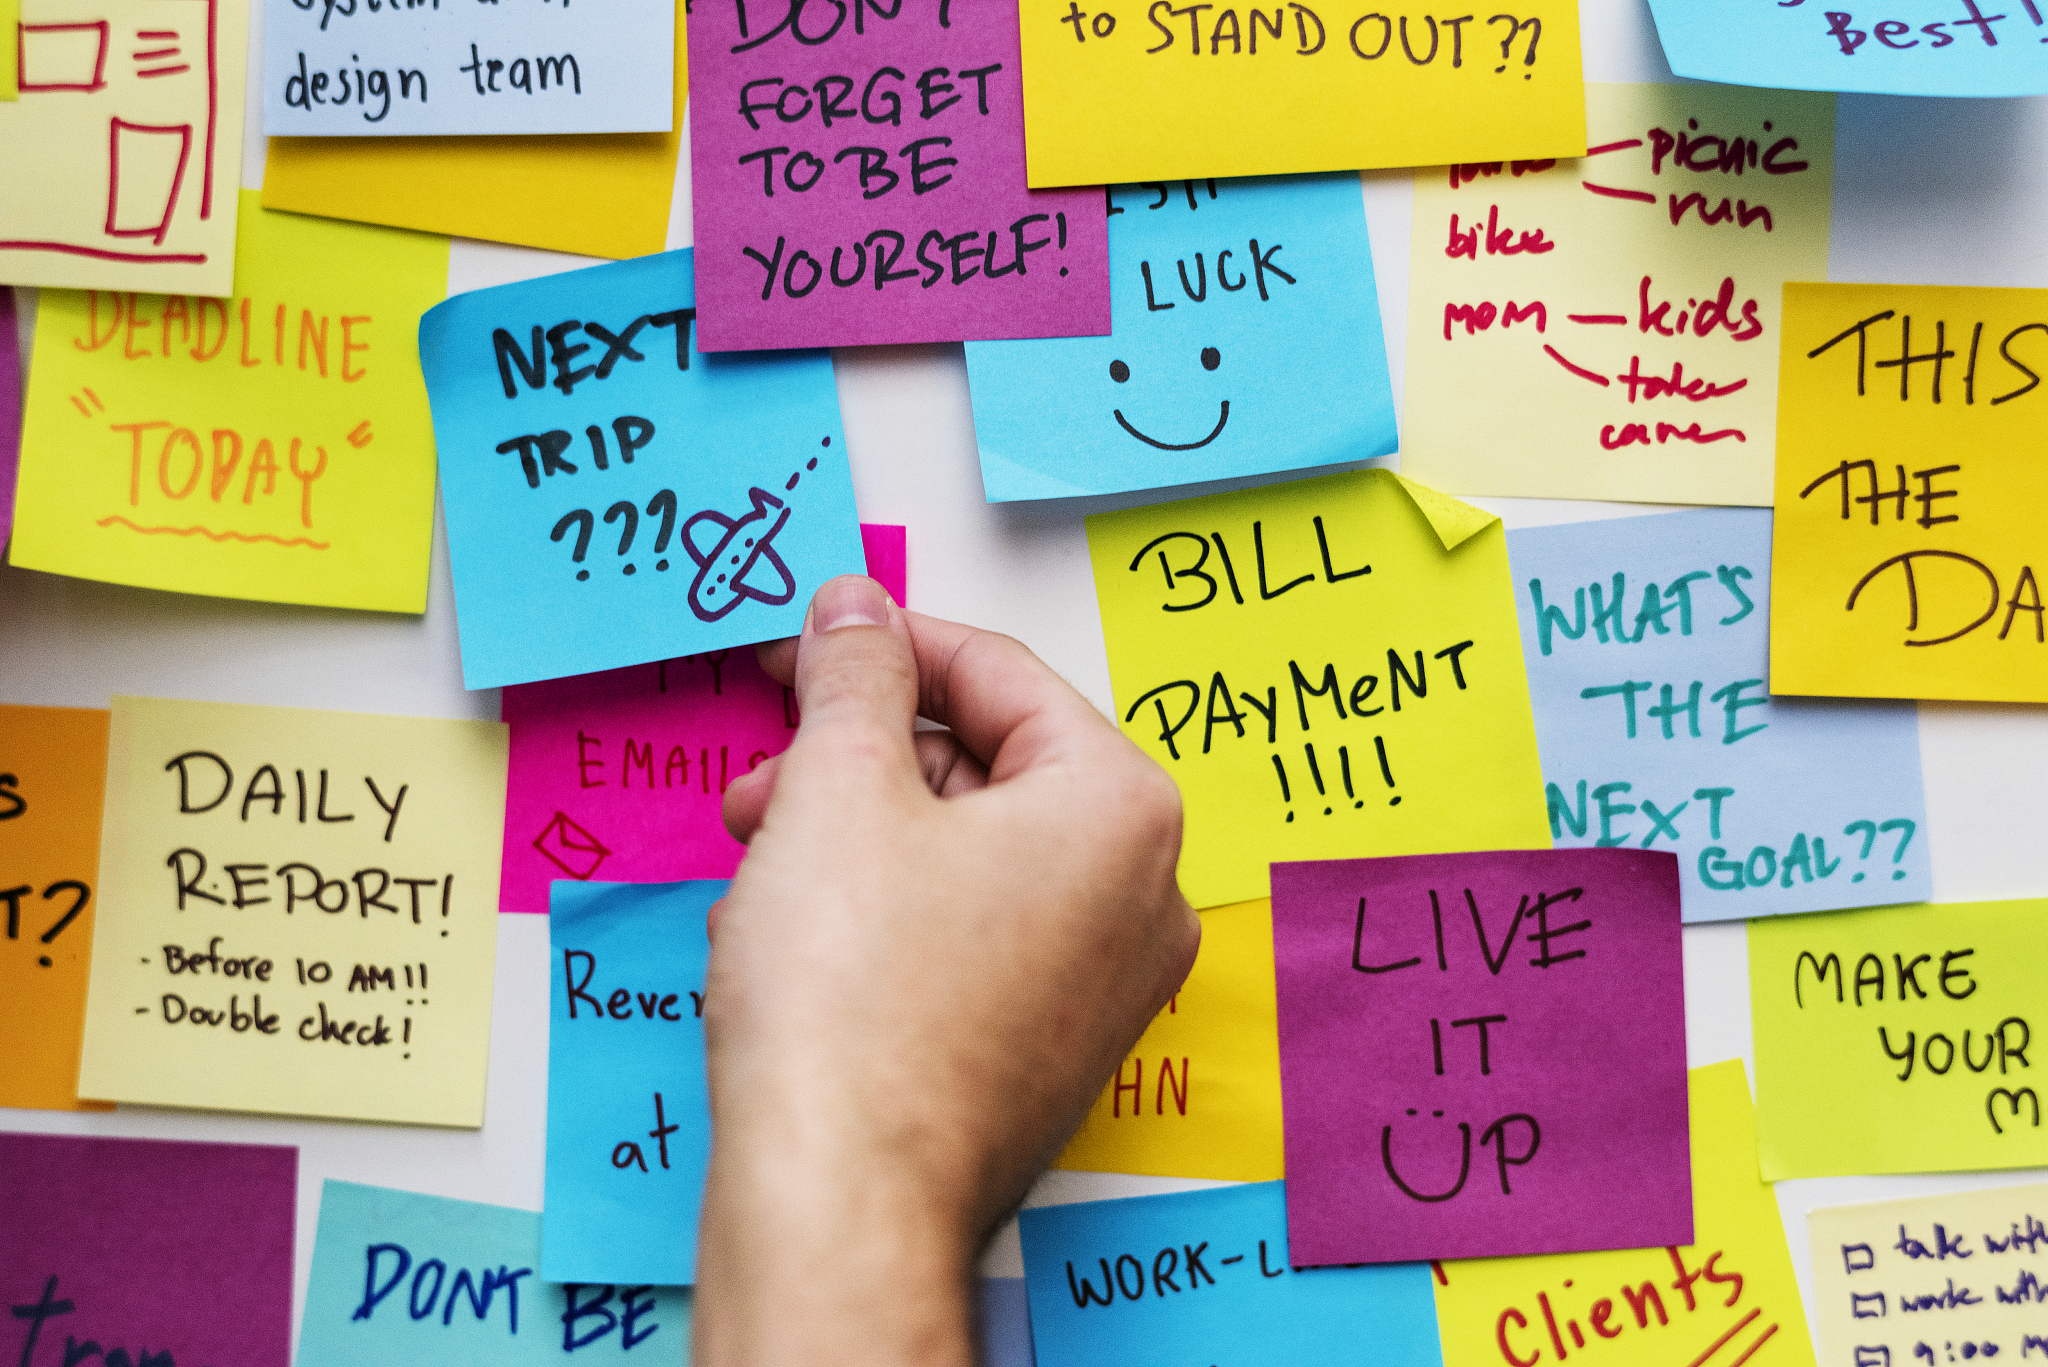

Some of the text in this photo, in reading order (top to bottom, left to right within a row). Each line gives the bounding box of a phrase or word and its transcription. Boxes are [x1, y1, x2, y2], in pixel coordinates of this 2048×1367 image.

[1146, 2, 1327, 57] STAND
[284, 43, 582, 122] design team
[738, 62, 1003, 130] FORGET
[738, 136, 959, 200] TO BE
[1648, 118, 1809, 176] picnic
[1445, 204, 1555, 261] bike
[1669, 192, 1773, 232] run
[742, 212, 1069, 301] YOURSELF!
[1140, 238, 1297, 312] LUCK
[74, 291, 373, 382] DEADLINE
[1638, 275, 1763, 342] kids
[492, 308, 697, 398] NEXT
[1807, 309, 2048, 405] THIS
[495, 414, 656, 488] TRIP
[1799, 459, 1961, 530] THE
[550, 489, 678, 581] ???
[1129, 515, 1372, 612] BILL
[1579, 678, 1769, 745] THE
[165, 750, 408, 842] DAILY
[1271, 735, 1403, 823] !!!!
[1544, 778, 1735, 849] NEXT
[1698, 817, 1917, 891] GOAL??
[167, 848, 454, 938] REPORT!
[163, 937, 275, 981] Before
[1351, 887, 1592, 975] LIVE
[1794, 948, 1978, 1009] MAKE
[161, 993, 281, 1036] Double
[298, 1004, 413, 1058] check!
[1430, 1013, 1508, 1076] IT
[1878, 1016, 2031, 1082] YOUR
[611, 1092, 680, 1173] at
[1893, 1223, 1973, 1260] talk
[561, 1283, 659, 1351] BE
[1496, 1245, 1744, 1367] Clients
[1899, 1277, 1983, 1312] work
